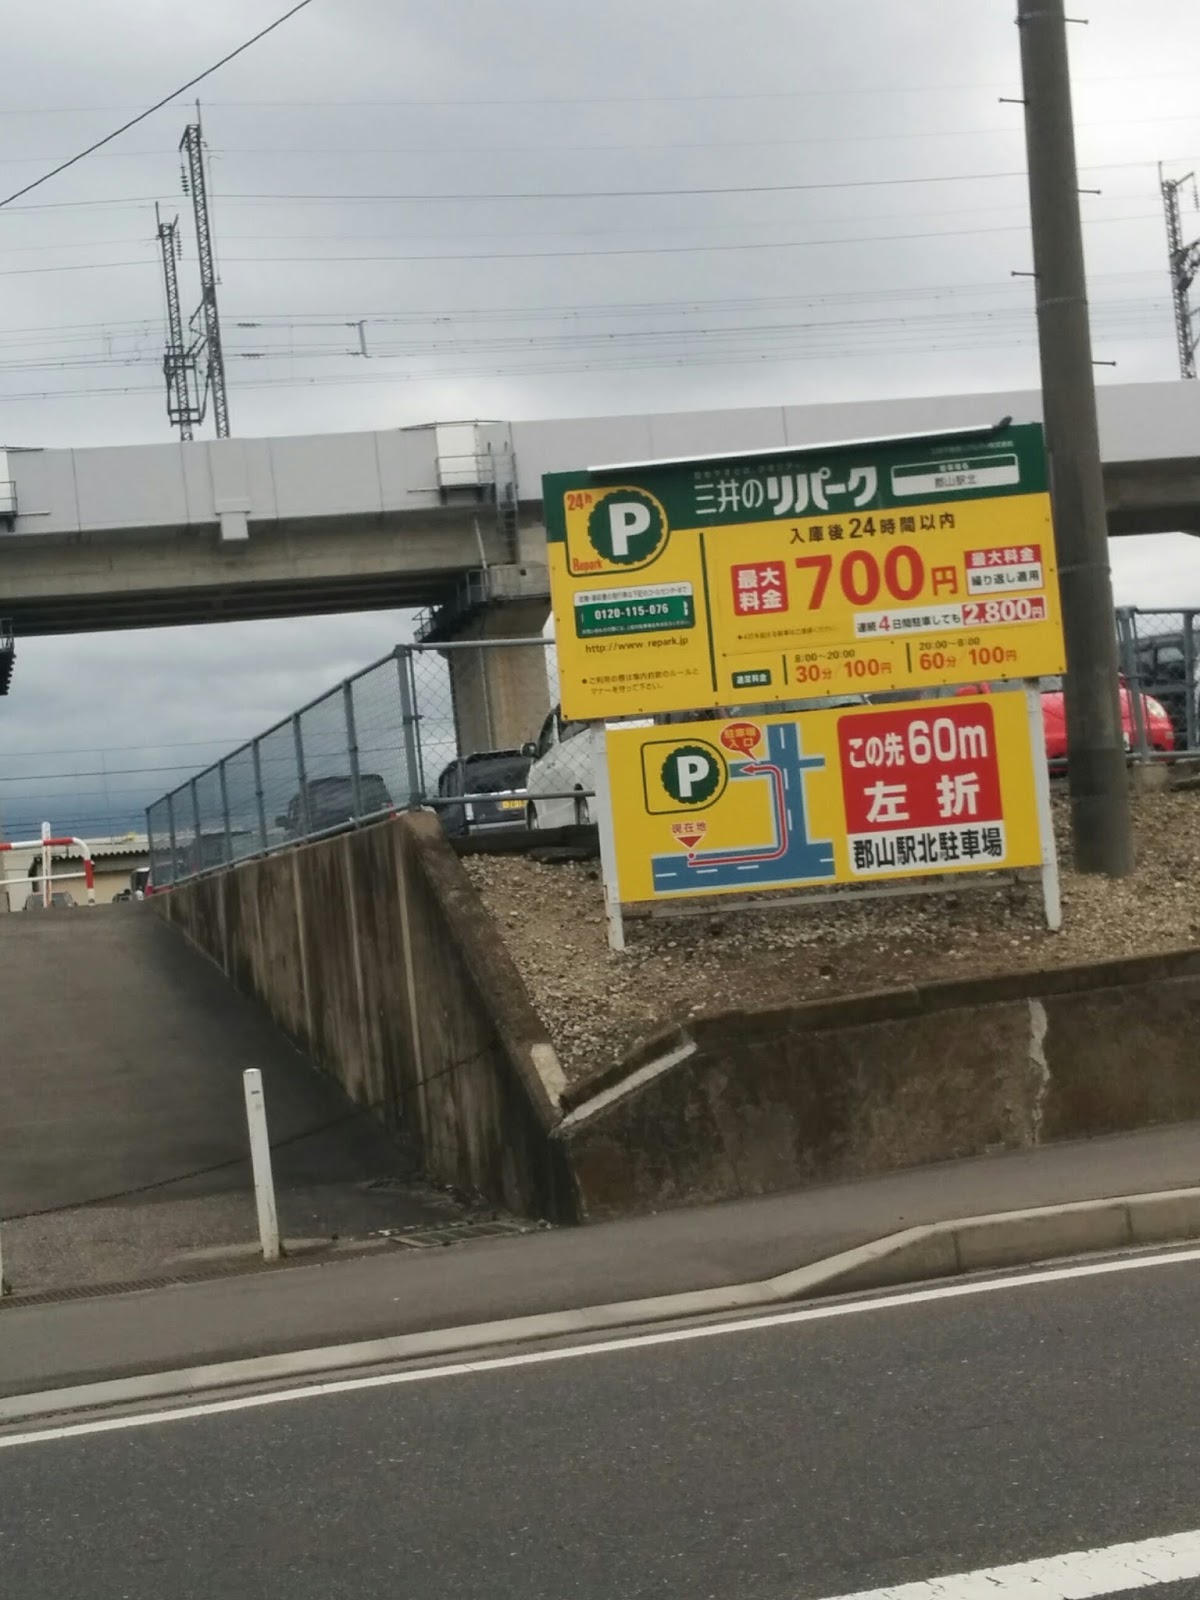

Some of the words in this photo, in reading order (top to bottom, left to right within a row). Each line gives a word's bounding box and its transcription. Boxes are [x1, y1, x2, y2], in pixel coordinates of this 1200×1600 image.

[694, 466, 878, 515] 三井のリパーク
[608, 502, 651, 557] P
[789, 513, 956, 544] 入庫後24時間以内
[971, 547, 1035, 566] 最大料金
[737, 567, 780, 588] 最大
[971, 569, 1040, 587] 繰り返し適用
[739, 589, 783, 611] 料金
[594, 603, 669, 620] 0120-115-076
[919, 652, 957, 671] 60分
[969, 646, 1018, 666] 100円
[796, 663, 832, 683] 30分
[844, 658, 892, 678] 100円
[725, 727, 757, 740] 駐車場
[728, 737, 754, 749] 入口
[677, 754, 710, 798] P
[671, 821, 707, 834] 現在地
[853, 827, 1003, 870] 郡山駅北駐車場
